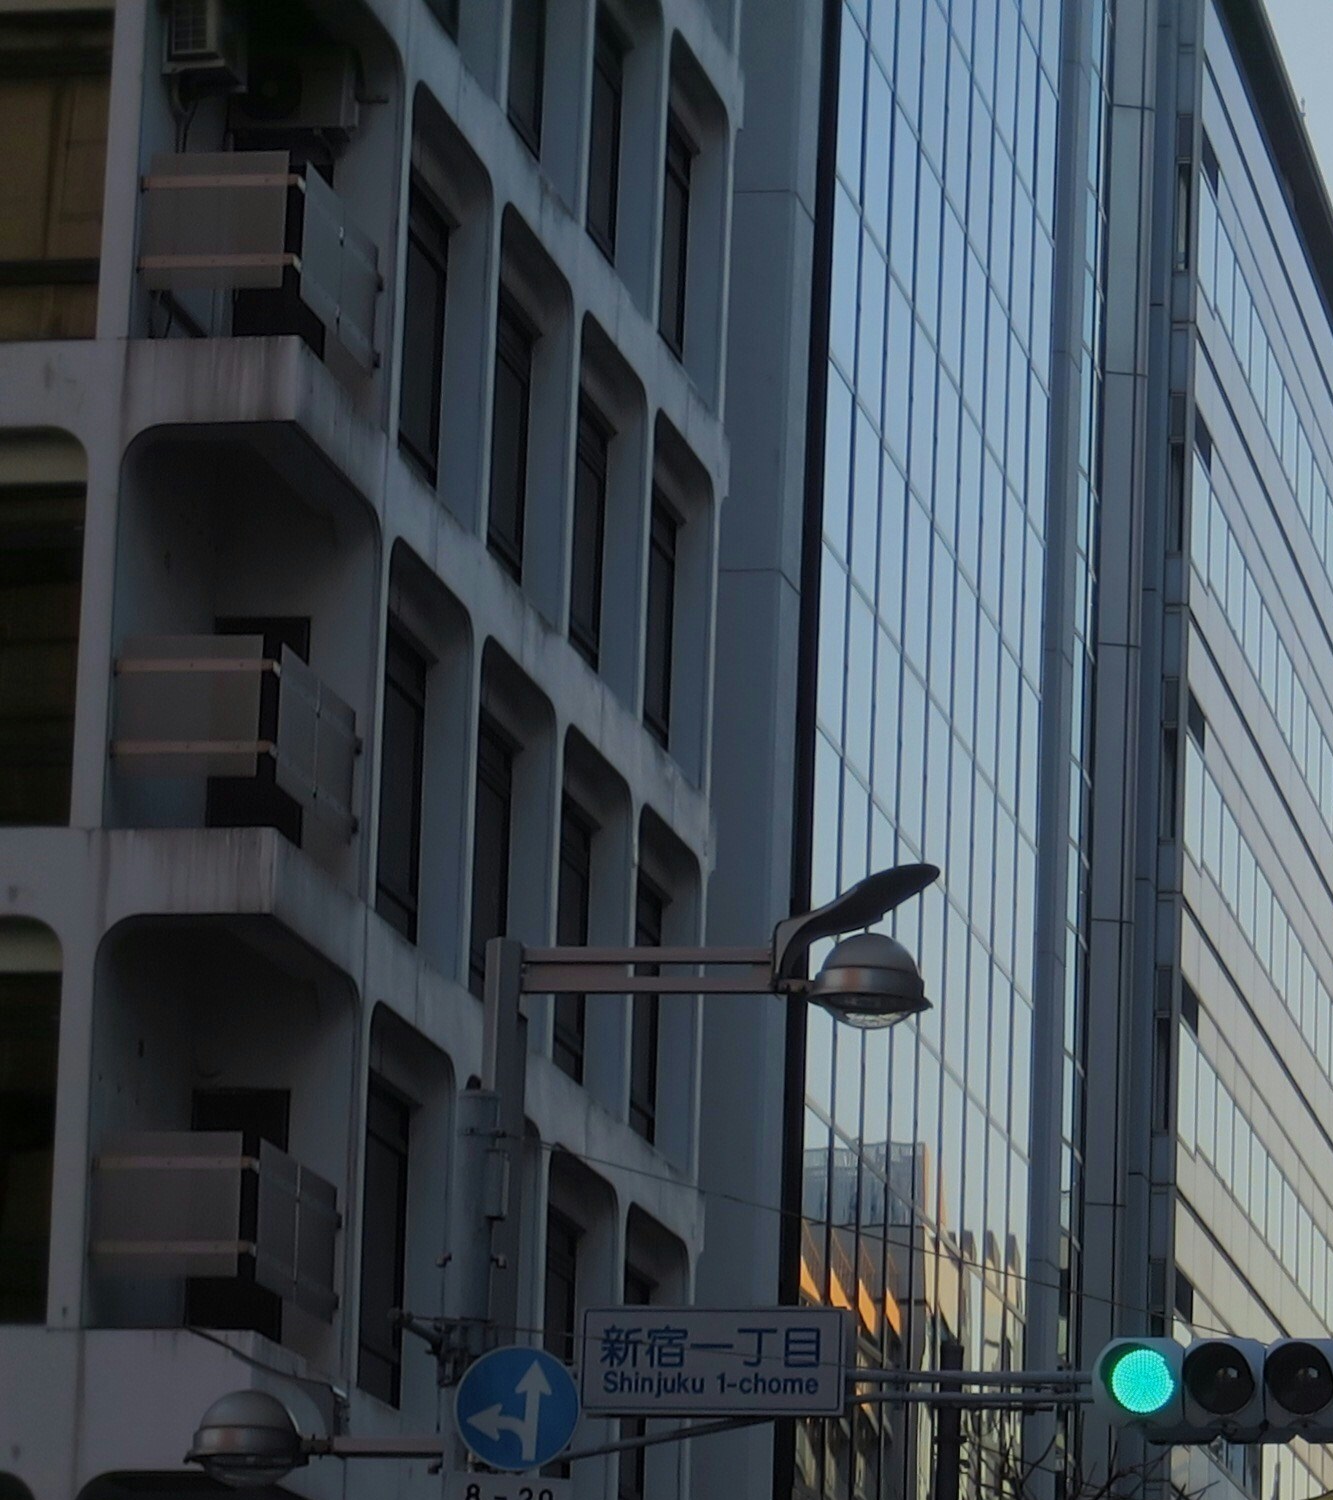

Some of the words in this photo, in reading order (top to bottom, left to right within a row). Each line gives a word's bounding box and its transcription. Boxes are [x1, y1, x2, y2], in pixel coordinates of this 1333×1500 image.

[601, 1325, 821, 1368] 新宿一丁目
[603, 1370, 705, 1398] Shinjuku
[716, 1373, 820, 1395] 1-chome
